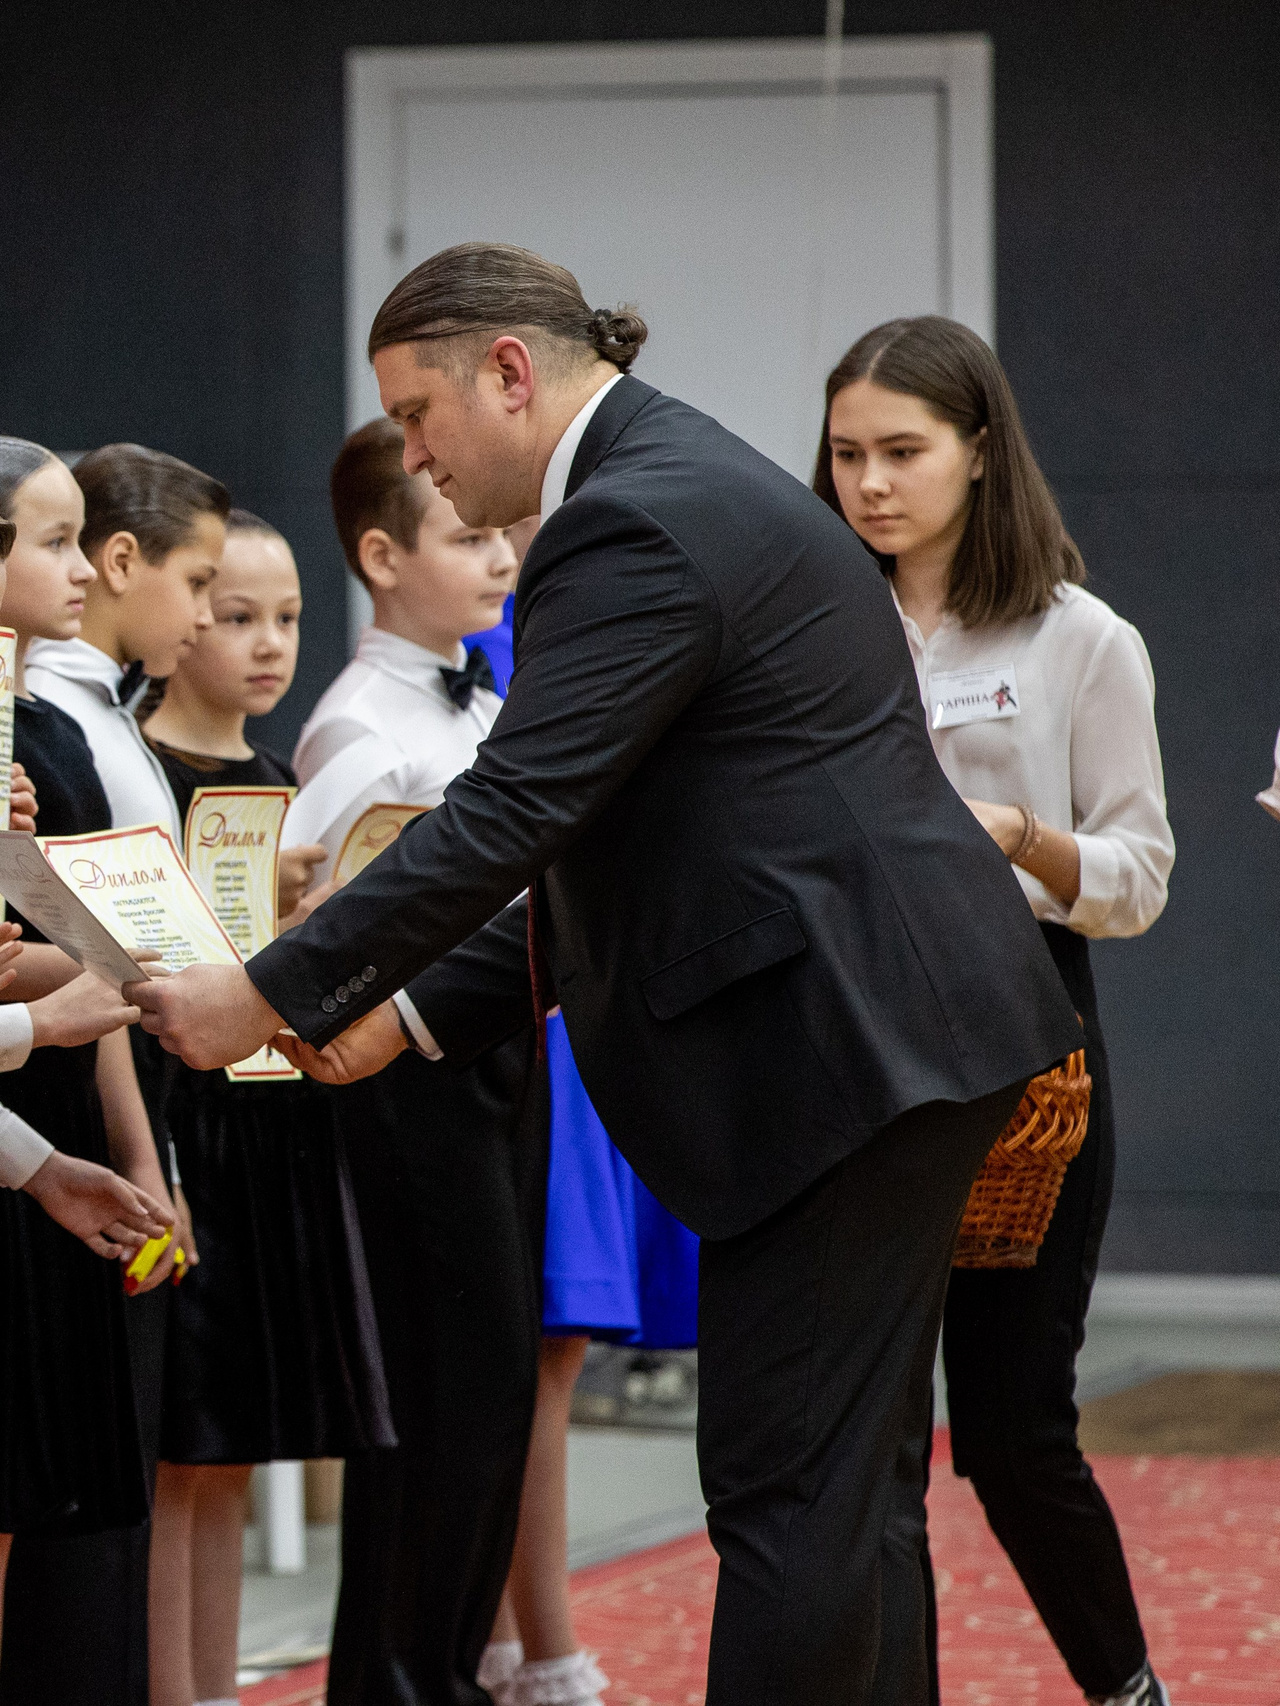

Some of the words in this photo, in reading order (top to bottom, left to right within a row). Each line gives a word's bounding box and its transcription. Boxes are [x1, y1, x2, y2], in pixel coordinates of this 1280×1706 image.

[936, 692, 990, 711] АРИНА
[198, 811, 266, 848] Диплом
[69, 859, 167, 890] Диплом
